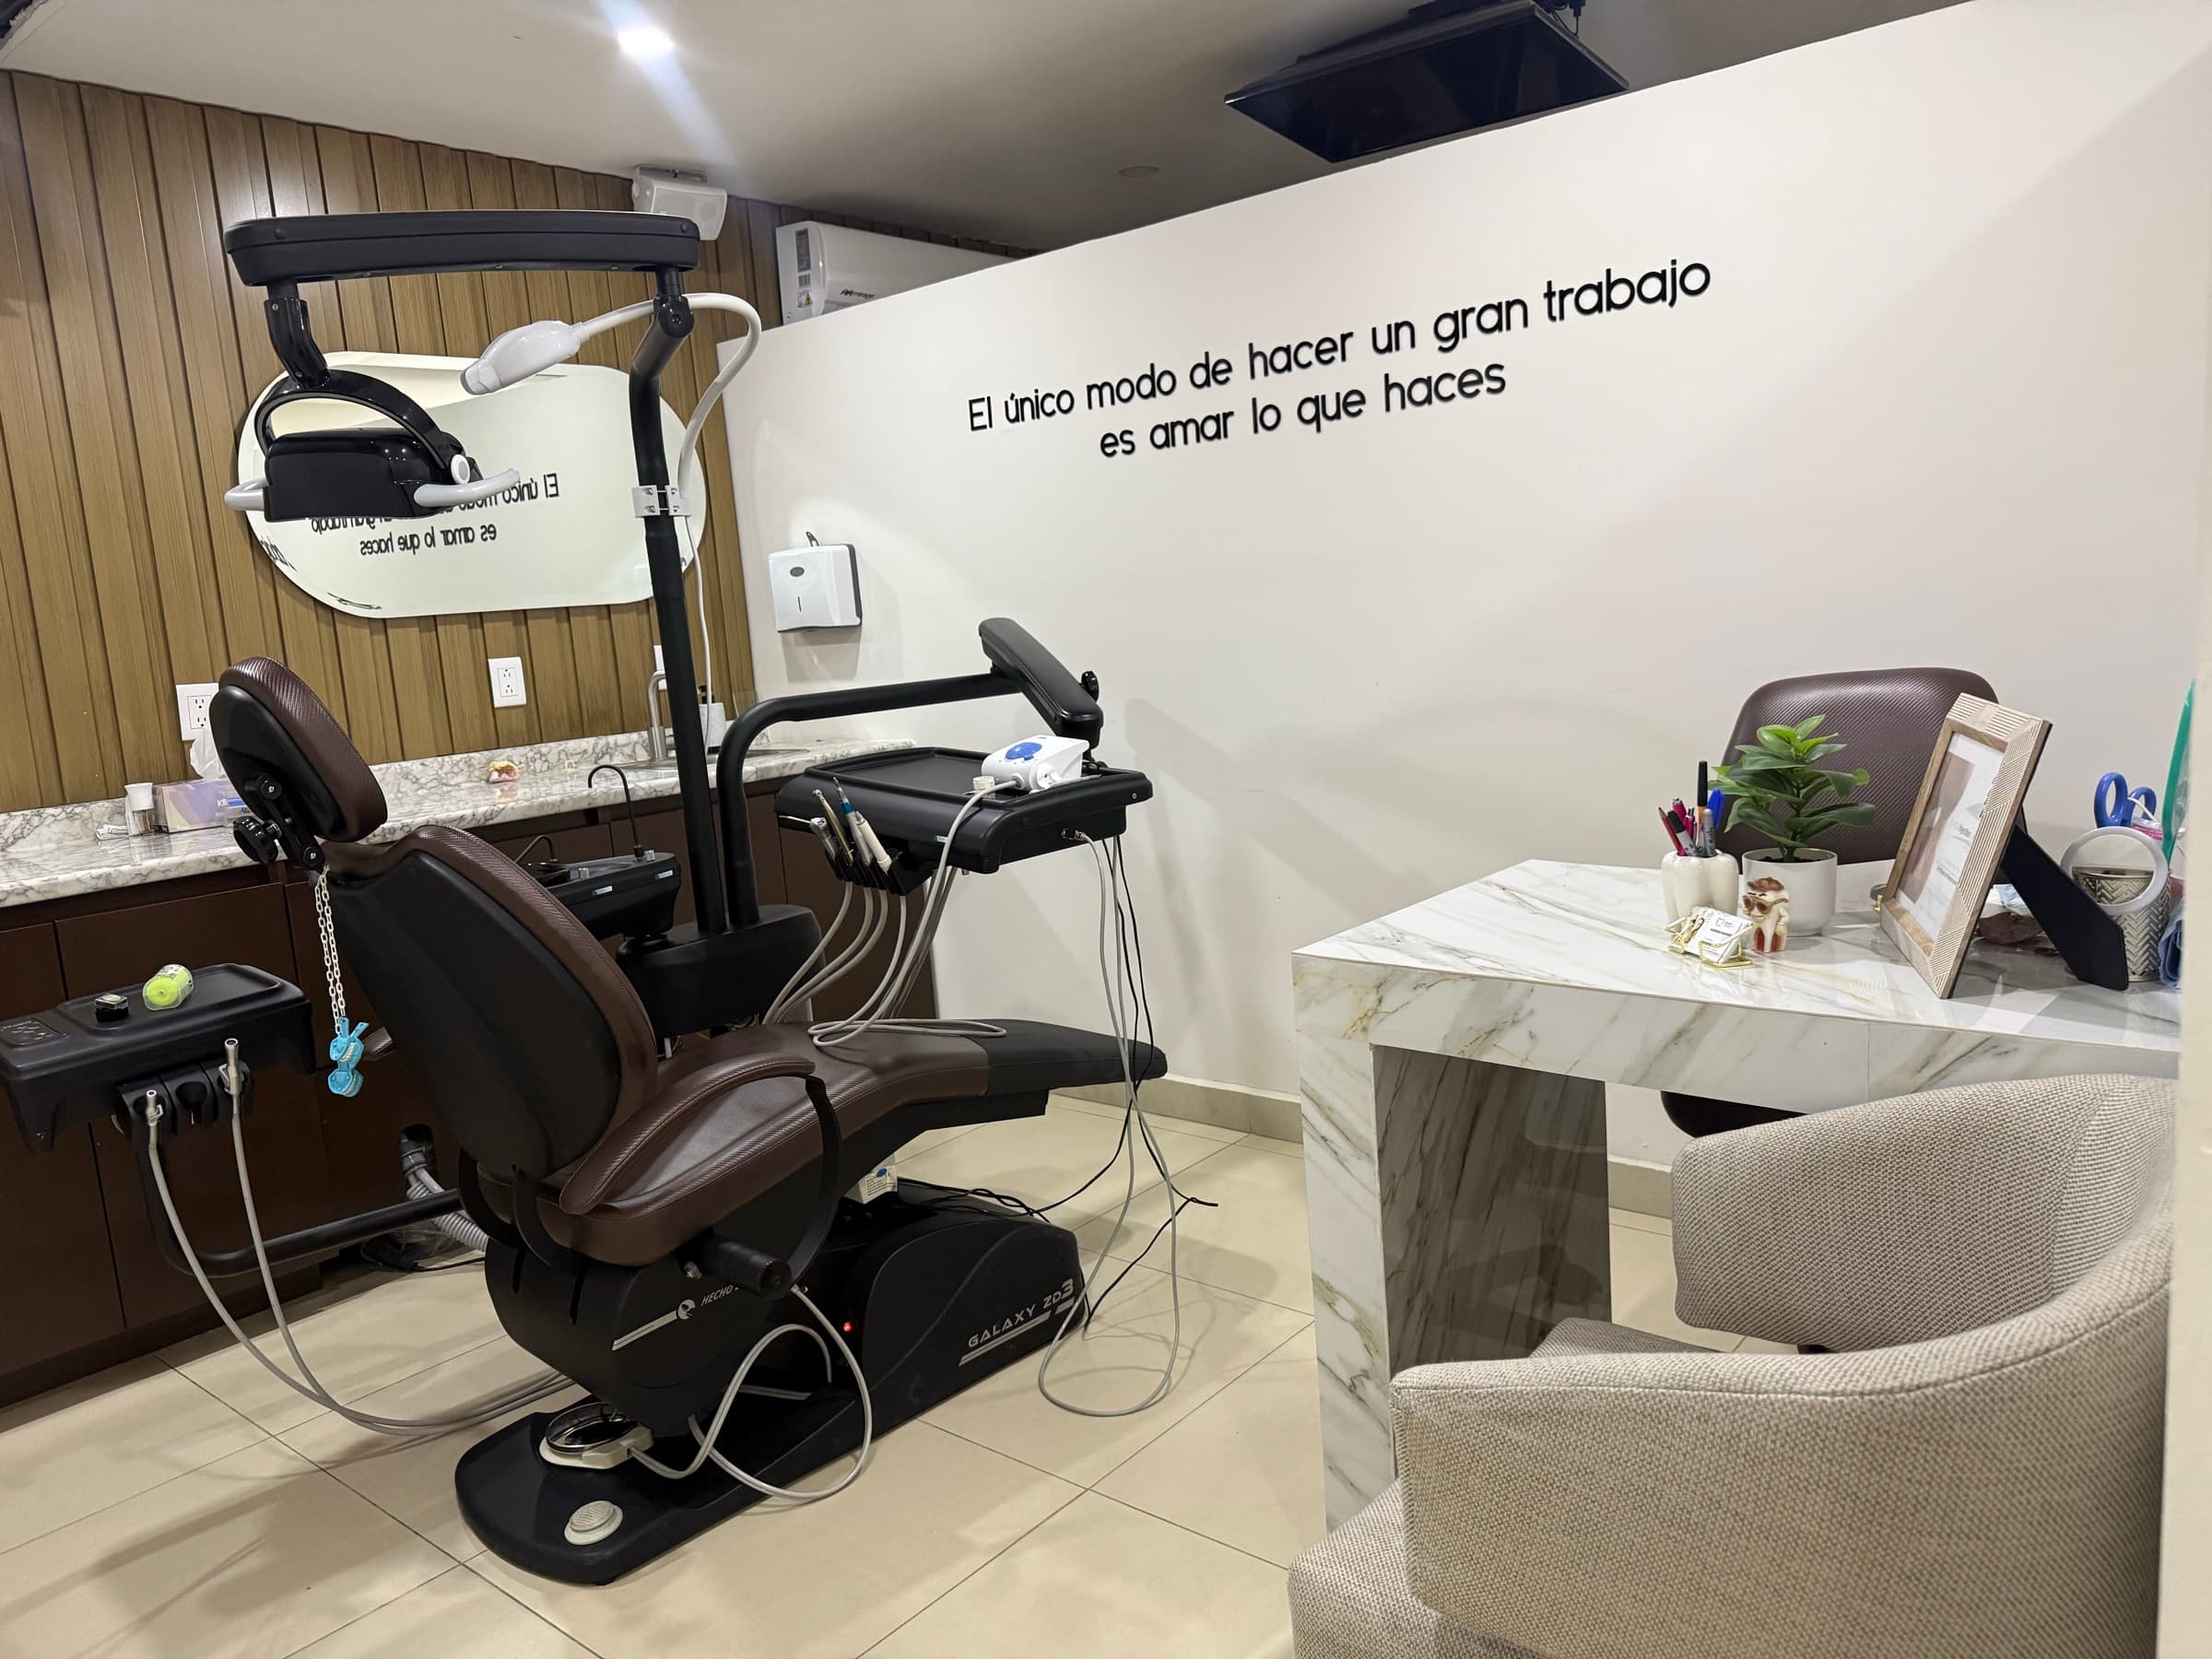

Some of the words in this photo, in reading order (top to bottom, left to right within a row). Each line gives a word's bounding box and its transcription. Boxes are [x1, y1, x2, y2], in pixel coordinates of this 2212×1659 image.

[968, 395, 994, 432] El
[1004, 388, 1076, 424] único
[1086, 362, 1177, 410] modo
[1189, 350, 1233, 390] de
[1248, 331, 1355, 381] hacer
[1371, 320, 1416, 356] un
[1432, 298, 1529, 354] gran
[1543, 258, 1712, 323] trabajo
[1100, 429, 1136, 458] es
[1149, 410, 1235, 451] amar
[1251, 396, 1282, 435] lo
[1296, 389, 1367, 434] que
[1383, 363, 1506, 413] haces
[700, 1285, 734, 1306] HECHO
[968, 1304, 1036, 1347] GALAXY
